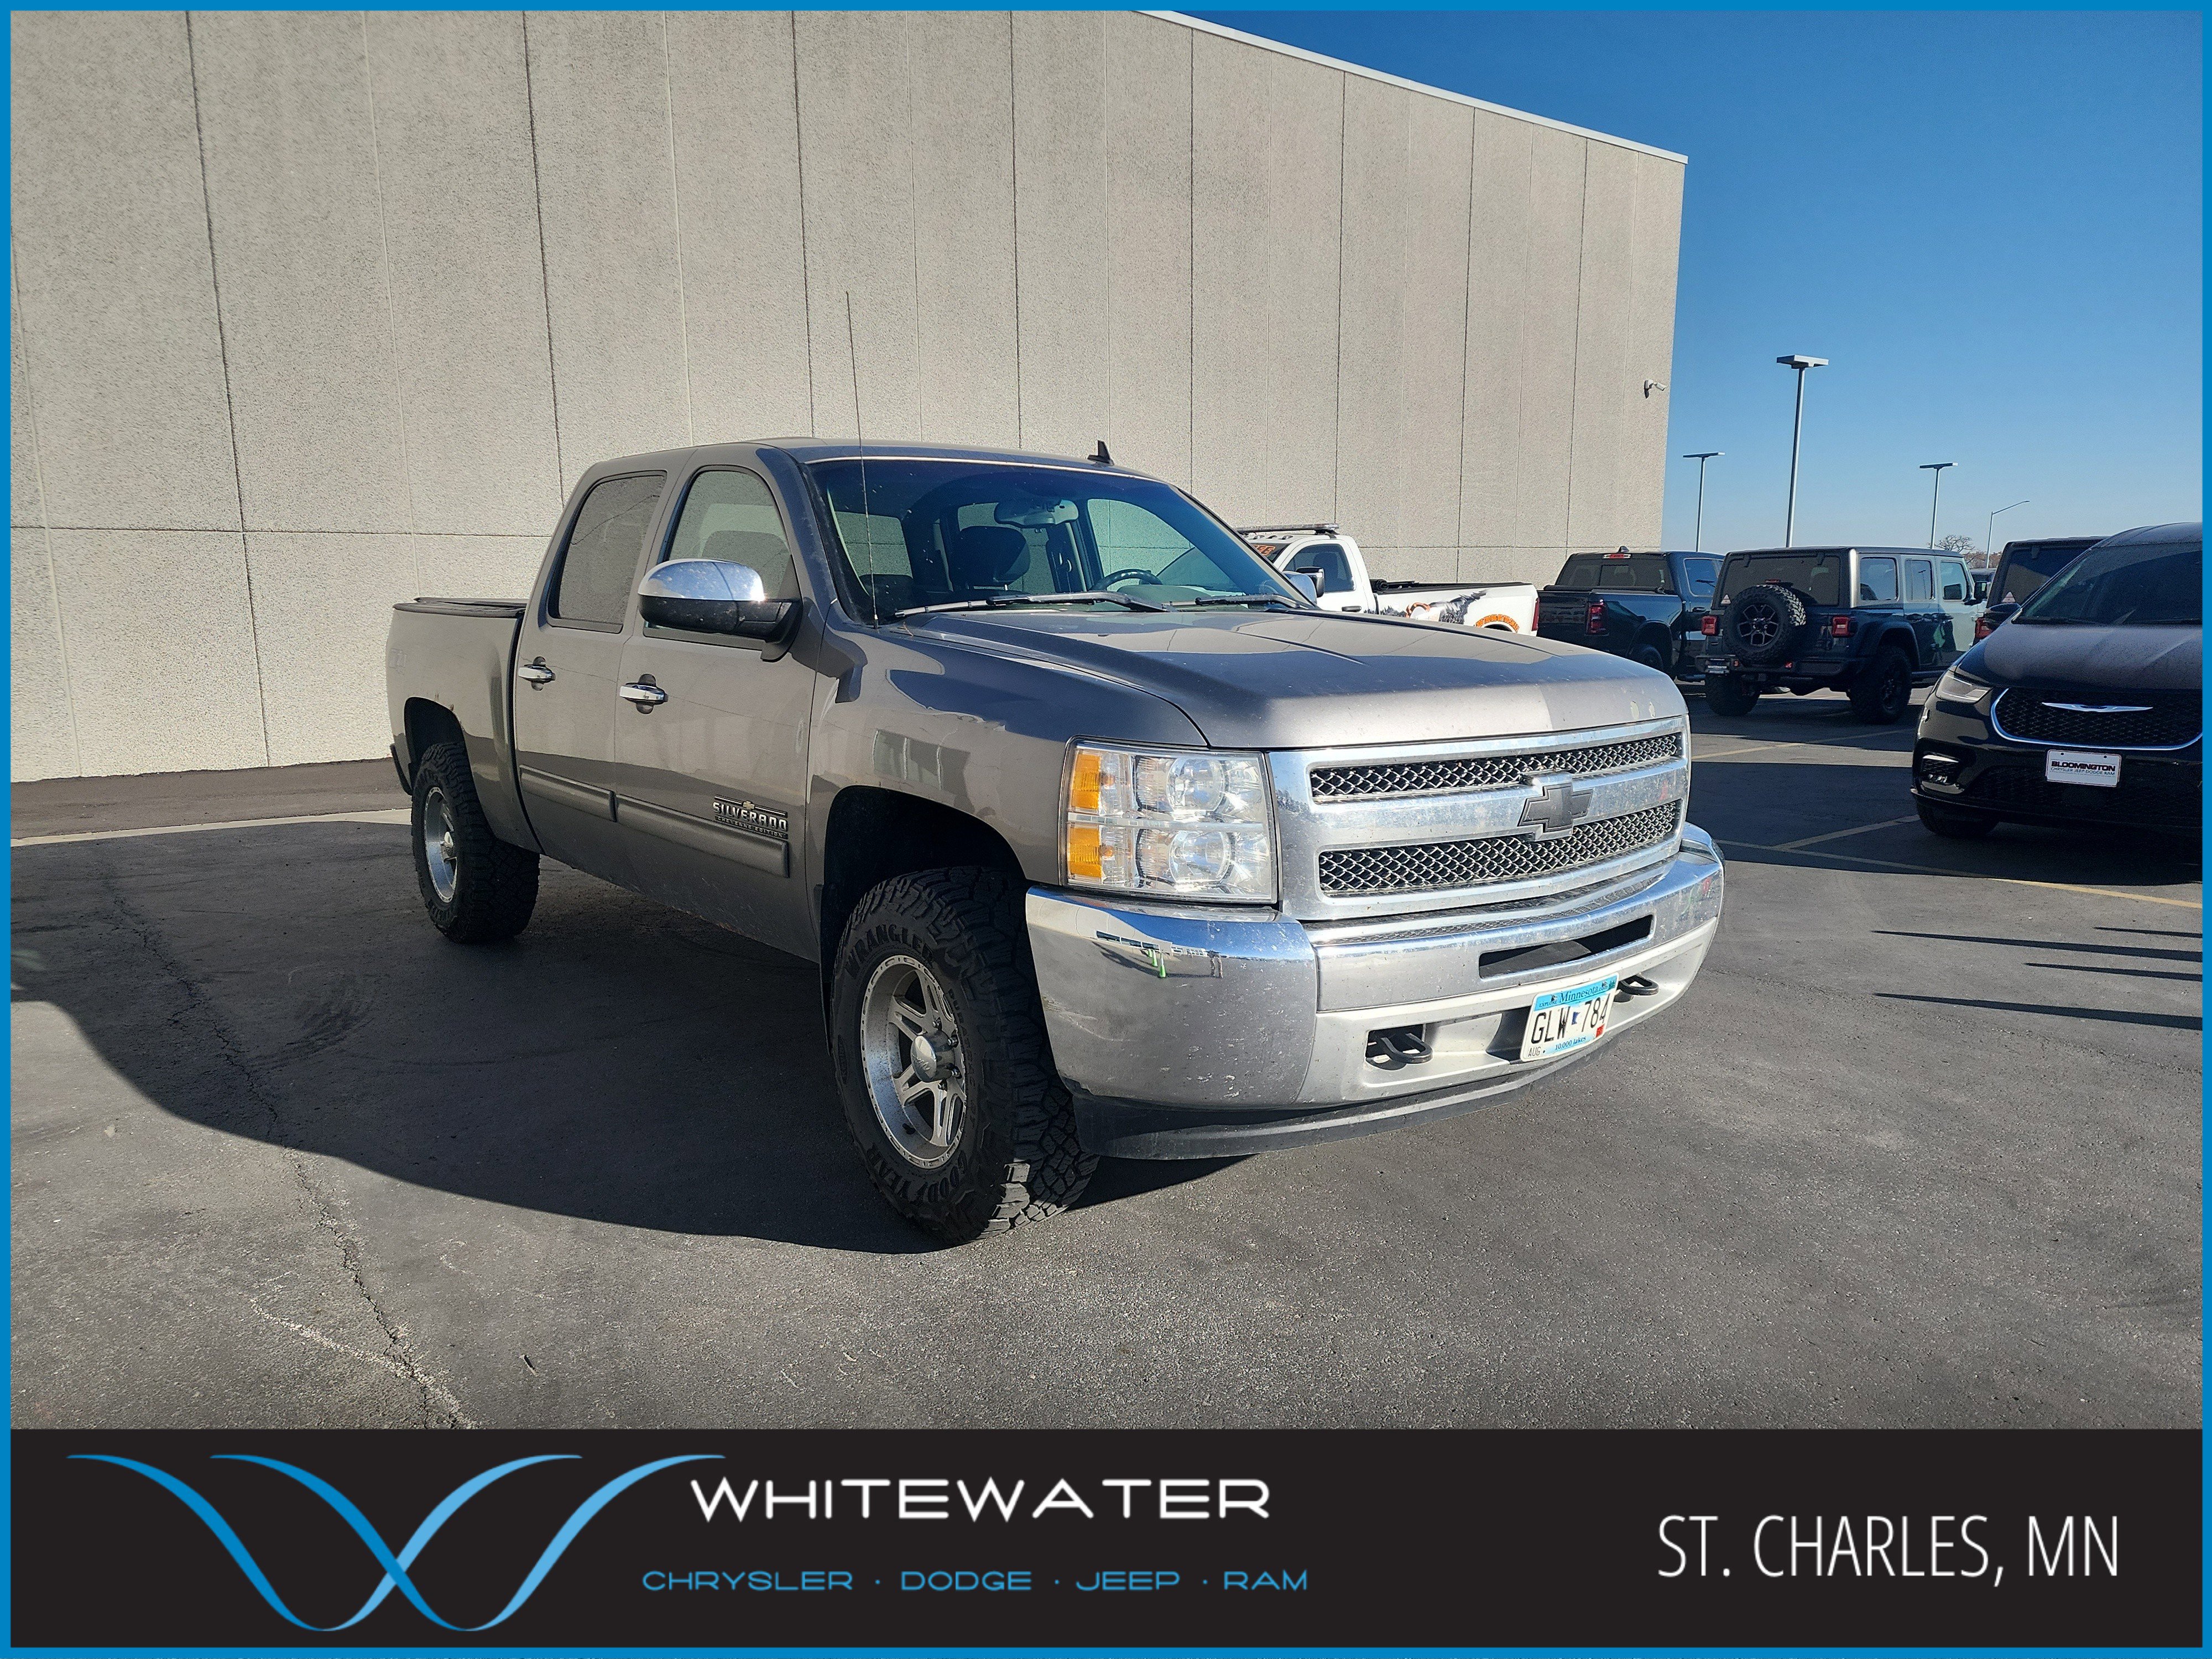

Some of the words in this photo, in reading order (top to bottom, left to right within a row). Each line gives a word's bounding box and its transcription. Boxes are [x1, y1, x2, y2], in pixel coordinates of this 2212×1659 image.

[2052, 761, 2115, 771] BLOOMINGTON
[713, 802, 787, 831] SILVERADO
[718, 816, 752, 830] CHEYENNE
[754, 826, 784, 838] EDITION
[844, 924, 934, 977] WRANGLER
[1531, 1006, 1571, 1044] GLW
[1581, 993, 1610, 1032] 784
[1528, 1046, 1541, 1057] AUG
[867, 1142, 967, 1206] GOODYEAR
